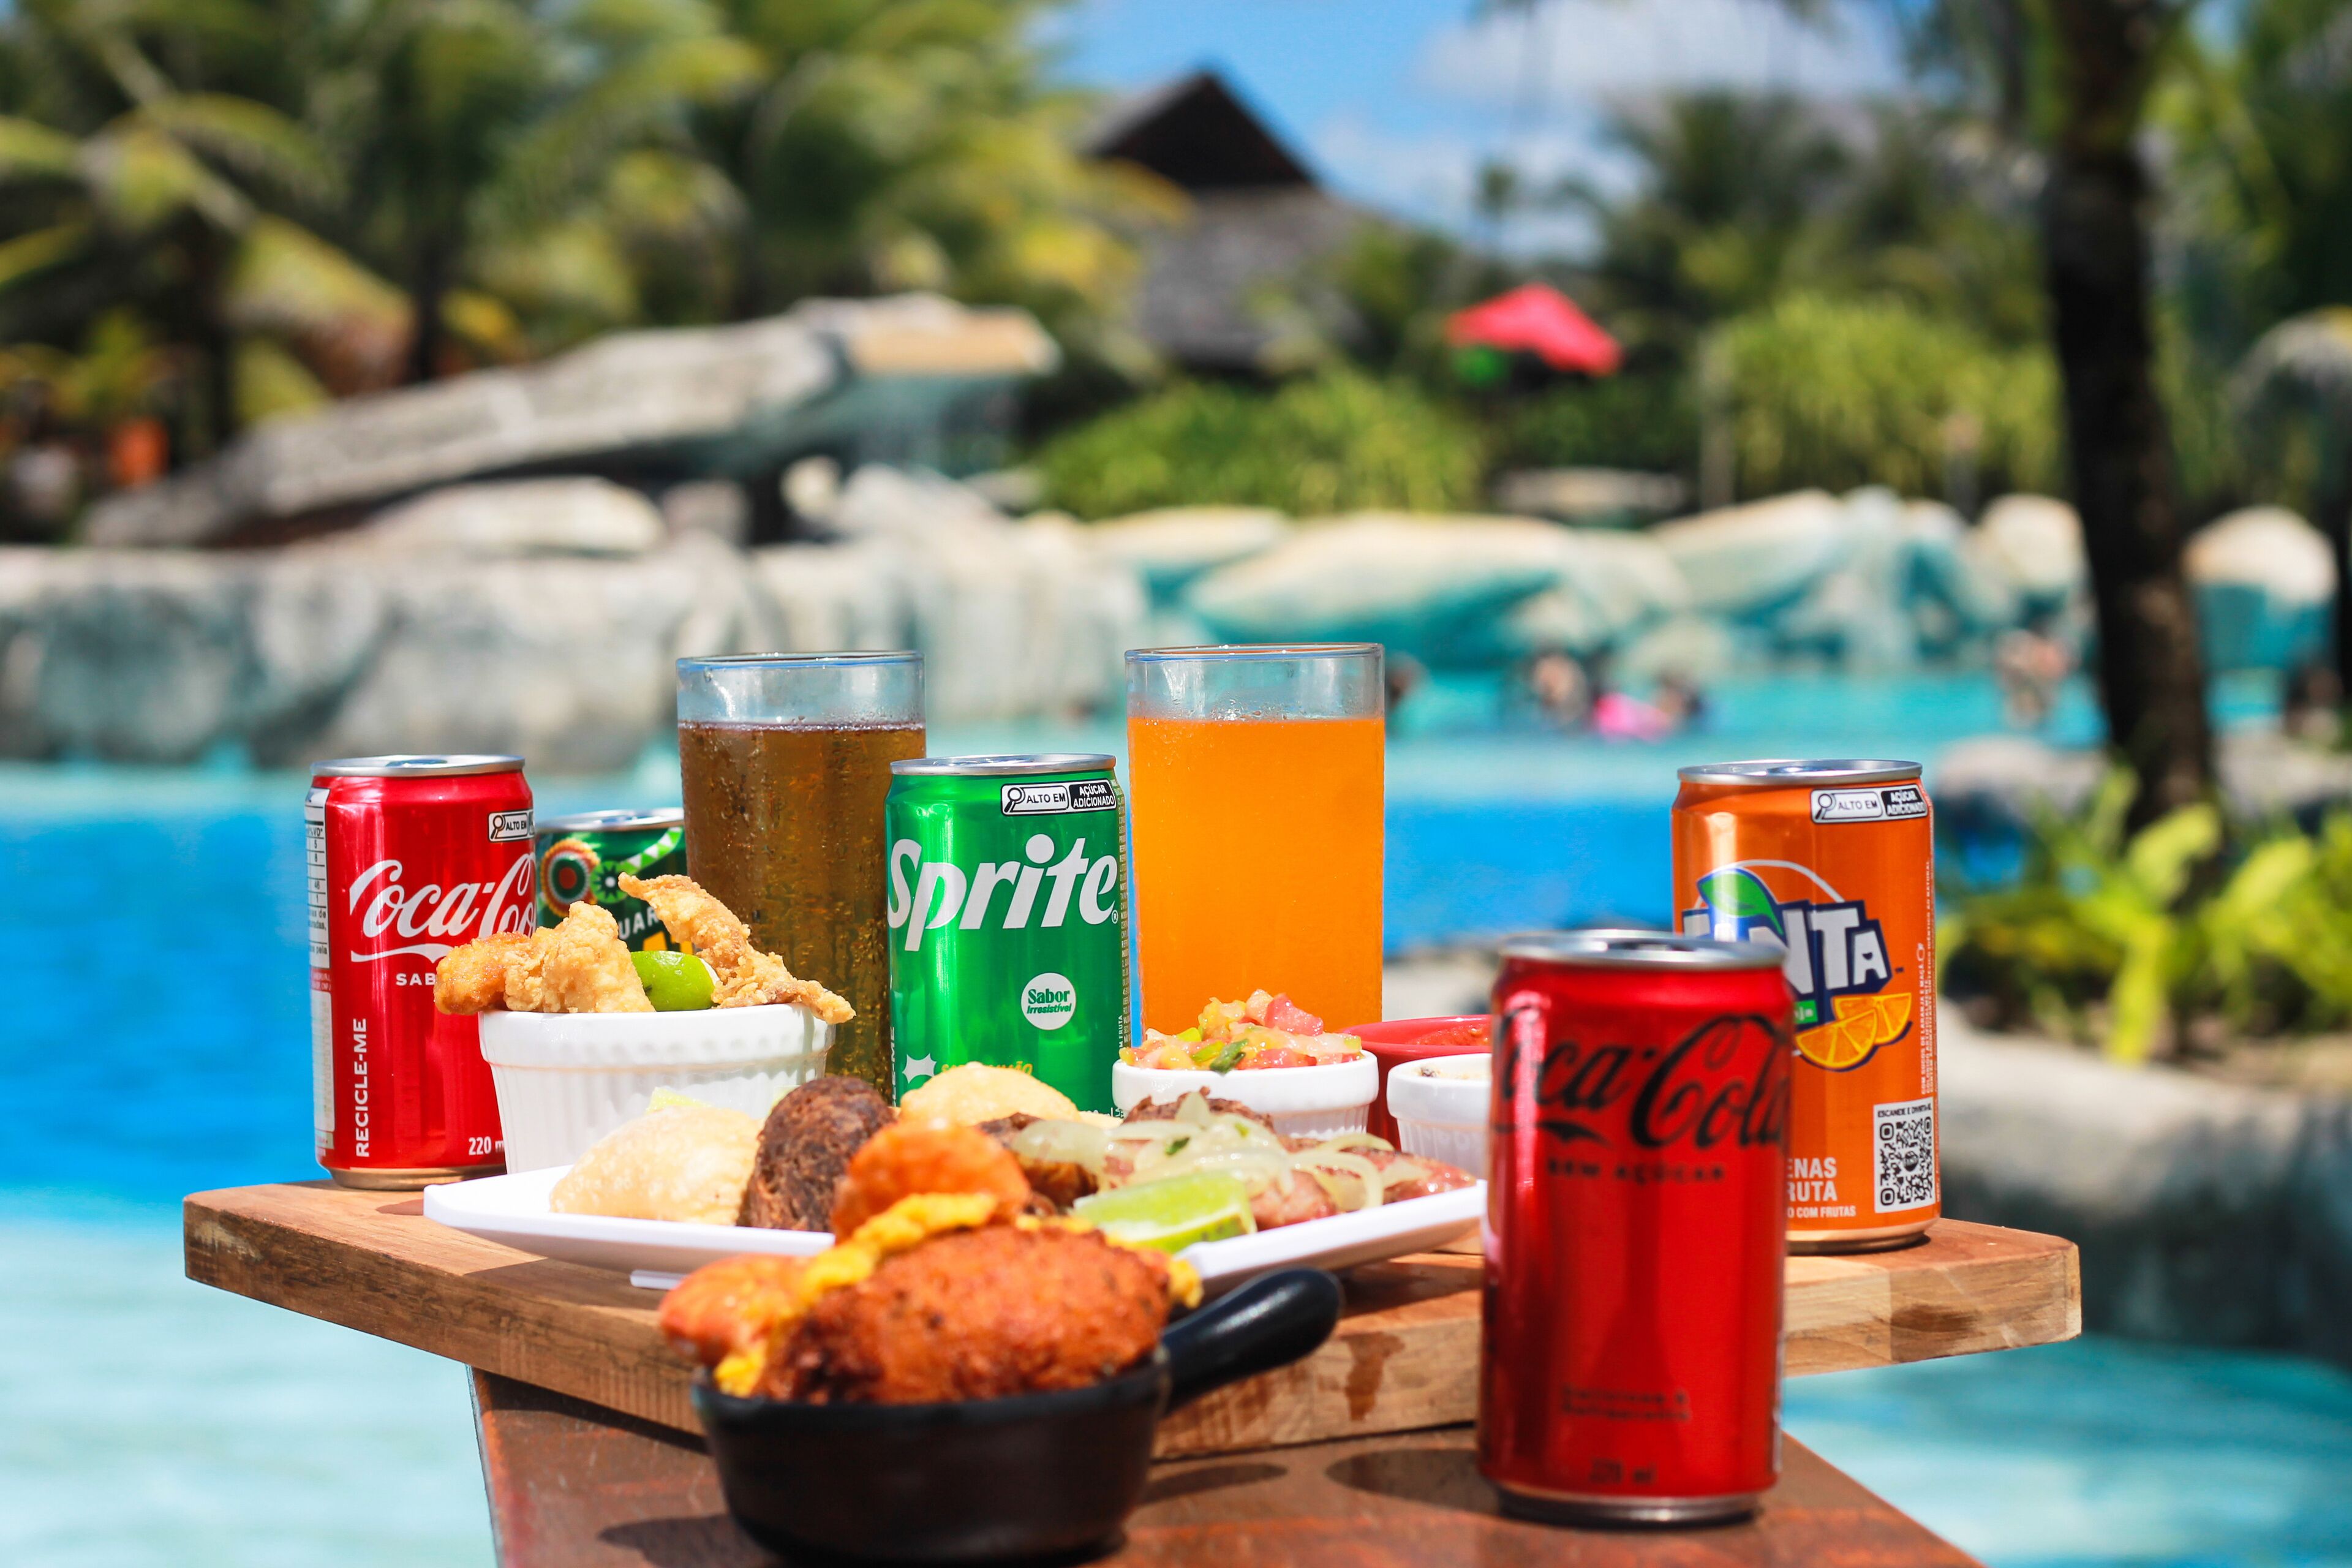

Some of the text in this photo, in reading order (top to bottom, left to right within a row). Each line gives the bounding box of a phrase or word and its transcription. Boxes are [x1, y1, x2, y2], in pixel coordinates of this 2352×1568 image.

[1026, 793, 1066, 804] ALTO EM
[1079, 784, 1107, 797] AÇÚCAR
[1073, 795, 1114, 808] ADICIONADO
[1838, 800, 1877, 810] ALTO EM
[505, 821, 520, 831] ALTO
[349, 852, 537, 941] Coca-Co
[888, 834, 1118, 952] Sprite
[1683, 902, 1891, 995] NTA
[396, 973, 436, 986] SAB
[1028, 988, 1070, 1004] Sabor
[352, 1018, 369, 1157] RECICLE-ME
[469, 1136, 505, 1156] 220 m
[1787, 1156, 1838, 1179] ENAS
[1788, 1180, 1838, 1202] RUTA
[1796, 1207, 1819, 1219] COM
[1820, 1205, 1856, 1218] FRUTAS
